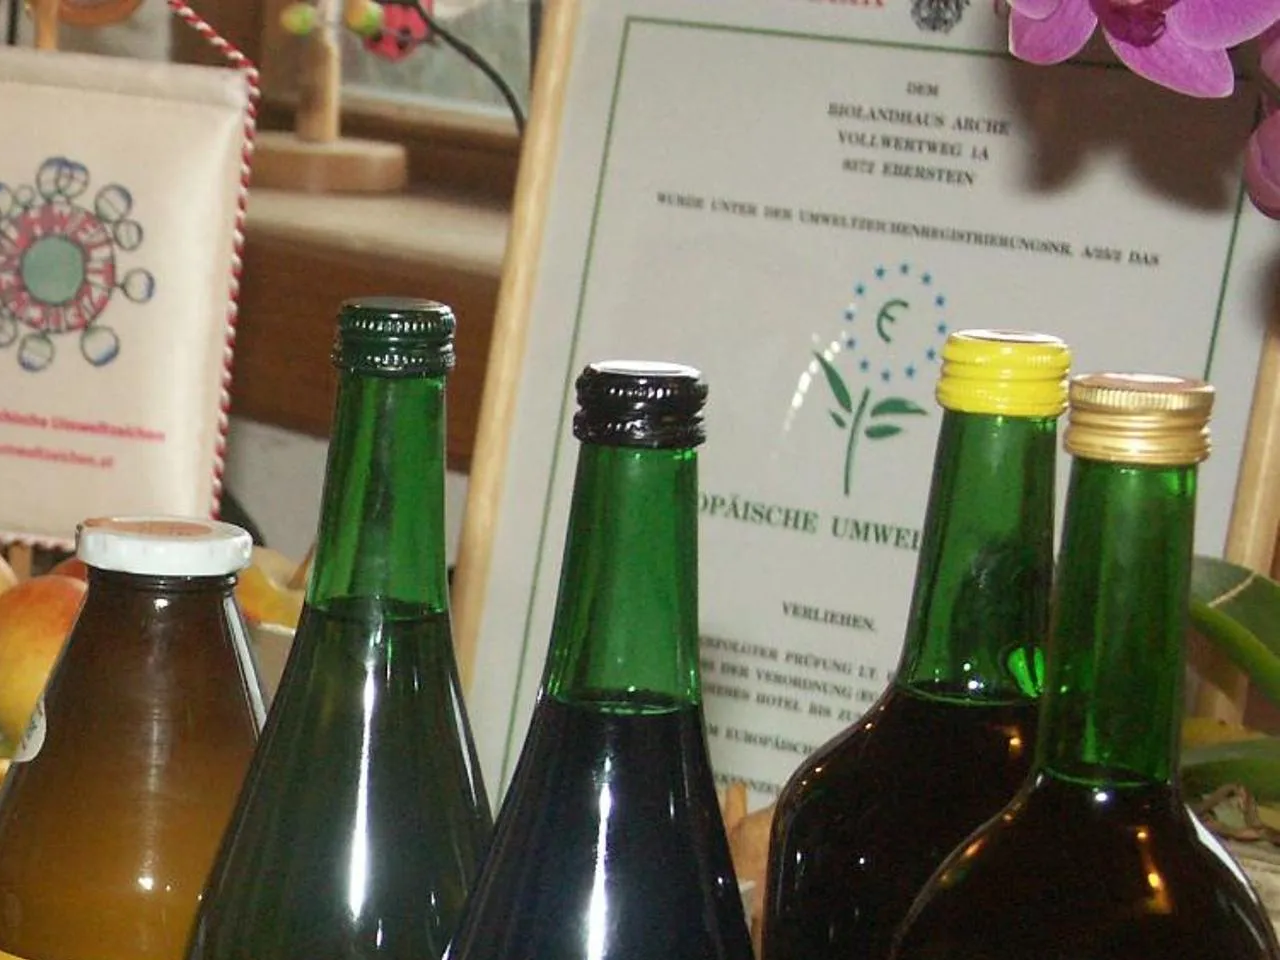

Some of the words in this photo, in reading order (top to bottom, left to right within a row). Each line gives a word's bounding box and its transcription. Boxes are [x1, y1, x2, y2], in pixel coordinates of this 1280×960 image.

[827, 102, 945, 127] BIOLANDHAUS
[952, 115, 1011, 136] ARCHE
[837, 130, 962, 157] VOLLWERTWEG
[882, 161, 974, 186] EBERSTEIN
